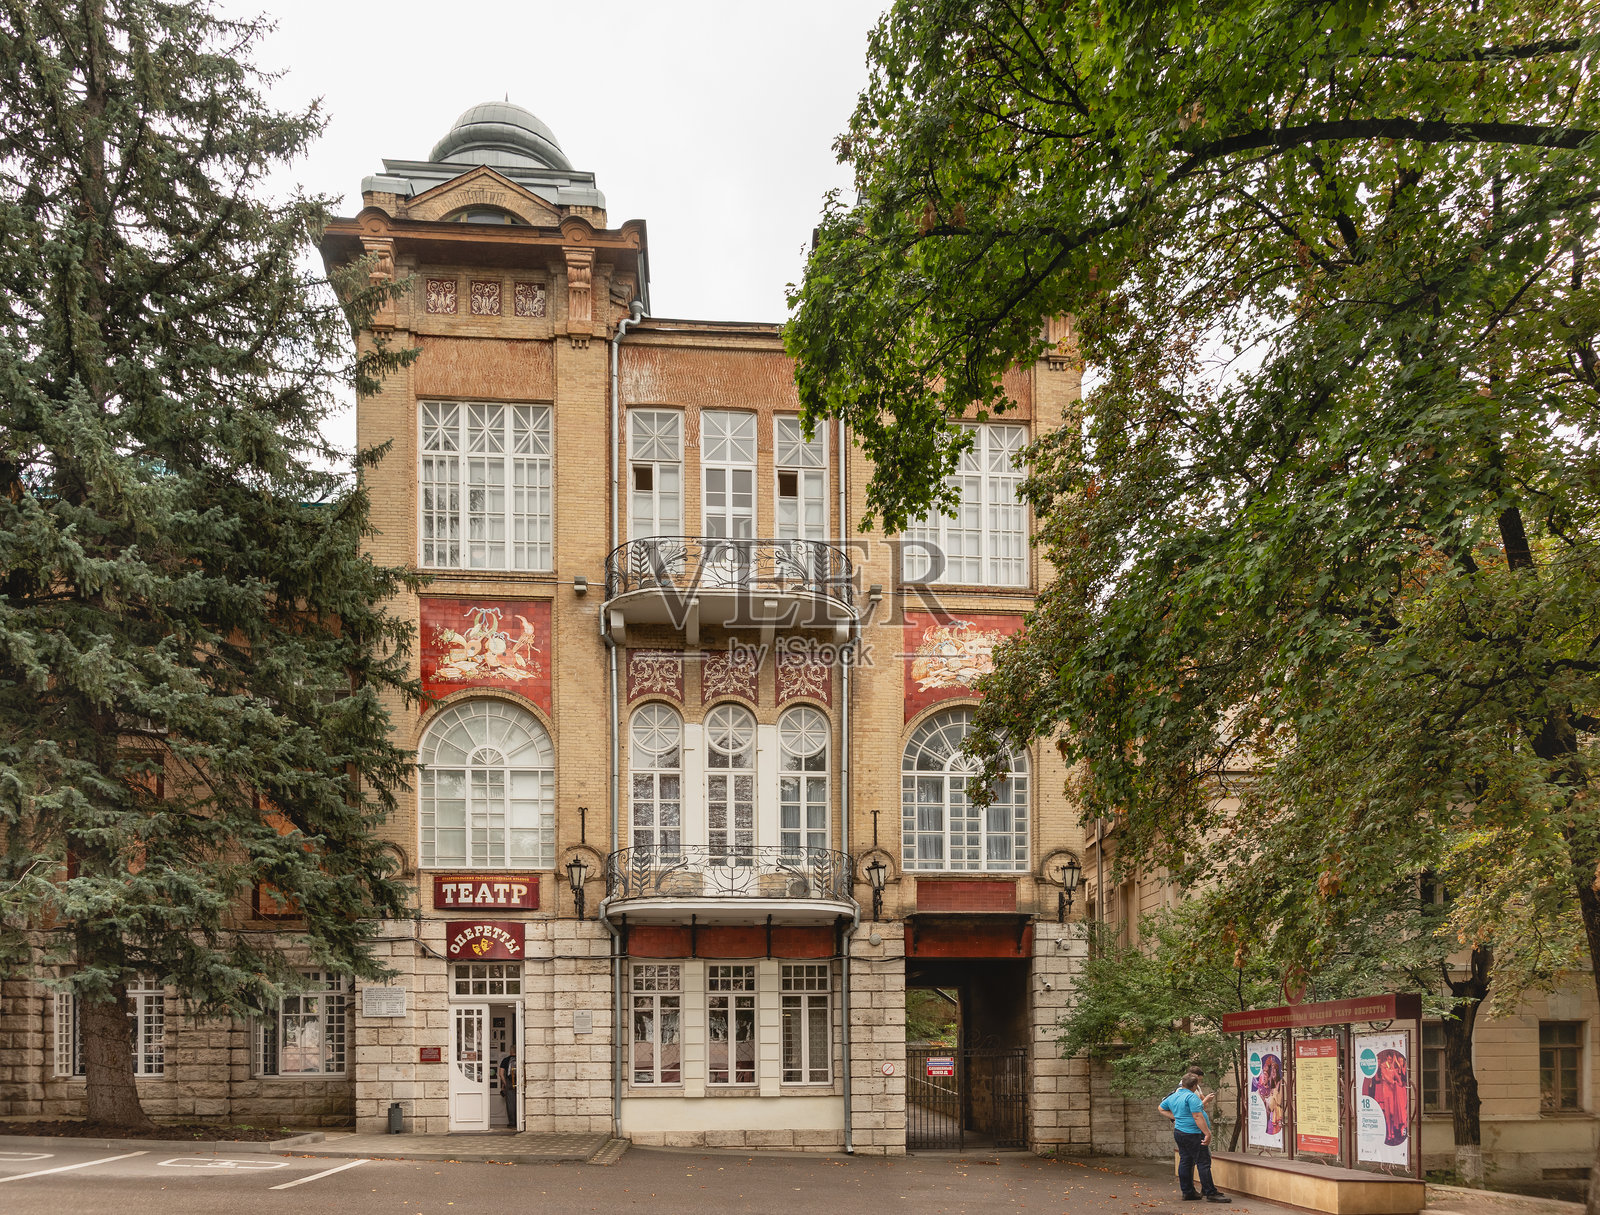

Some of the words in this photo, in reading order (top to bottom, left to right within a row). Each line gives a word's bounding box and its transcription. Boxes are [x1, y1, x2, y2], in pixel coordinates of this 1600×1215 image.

[442, 883, 528, 904] ТЕАТР
[450, 925, 520, 954] ОПЕРЕТТЫ
[1335, 1008, 1352, 1017] ТЕАТР
[1354, 1005, 1386, 1015] ОПЕРЕТТЫ
[1250, 1095, 1257, 1104] 19
[1361, 1098, 1370, 1109] 18
